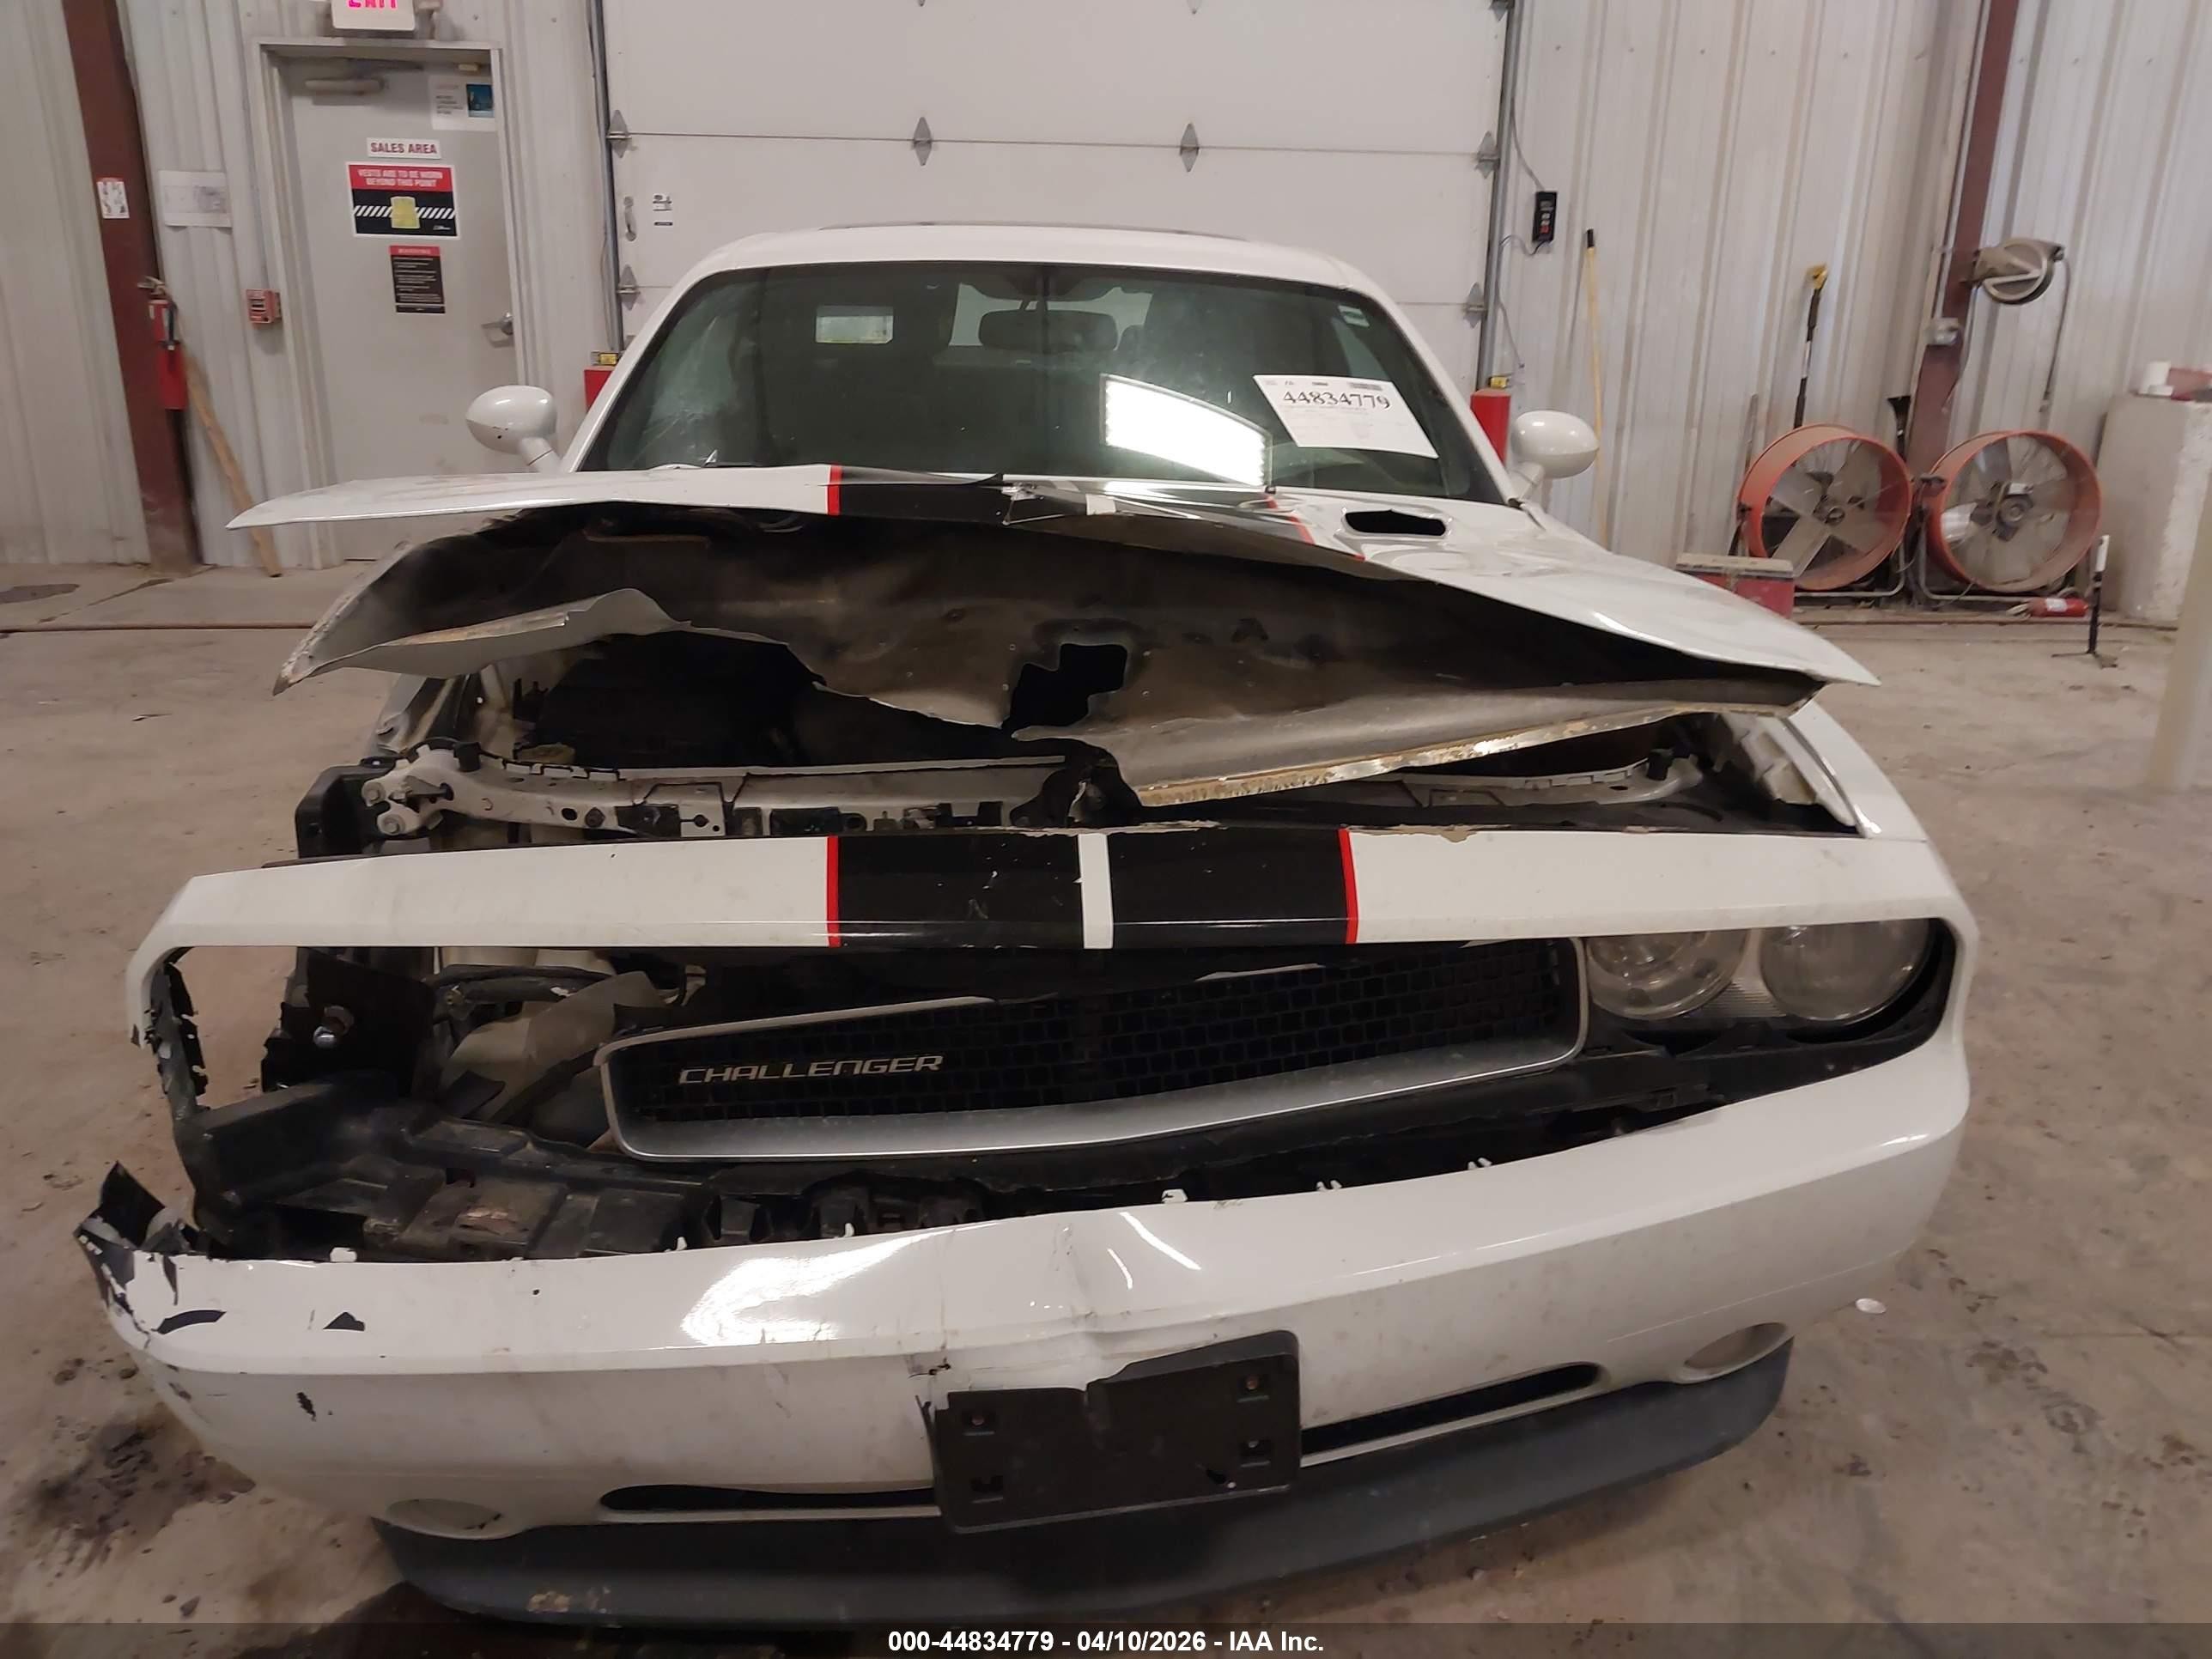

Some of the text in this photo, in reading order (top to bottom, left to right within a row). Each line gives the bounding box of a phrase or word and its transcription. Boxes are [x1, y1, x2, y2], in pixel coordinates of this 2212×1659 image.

[370, 143, 437, 154] SALES AREA
[1284, 391, 1391, 410] 44834779
[678, 1054, 944, 1085] CHALLENGER
